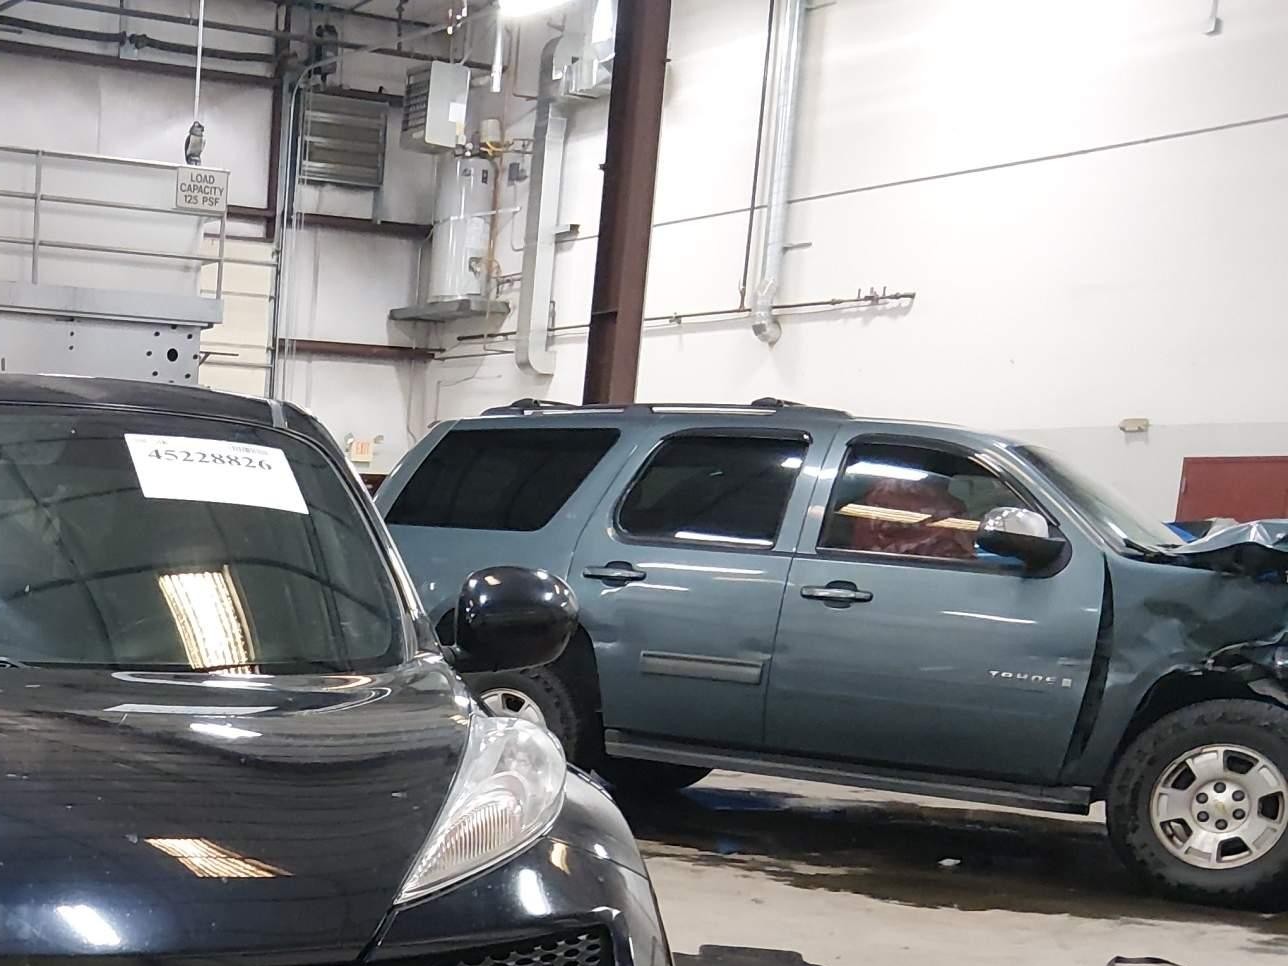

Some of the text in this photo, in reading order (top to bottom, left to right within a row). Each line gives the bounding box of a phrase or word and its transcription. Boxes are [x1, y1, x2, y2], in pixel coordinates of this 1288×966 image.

[190, 173, 215, 183] LOAD
[179, 183, 224, 196] CAPACITY
[184, 194, 220, 206] 125 PSF
[148, 449, 272, 470] 45228826
